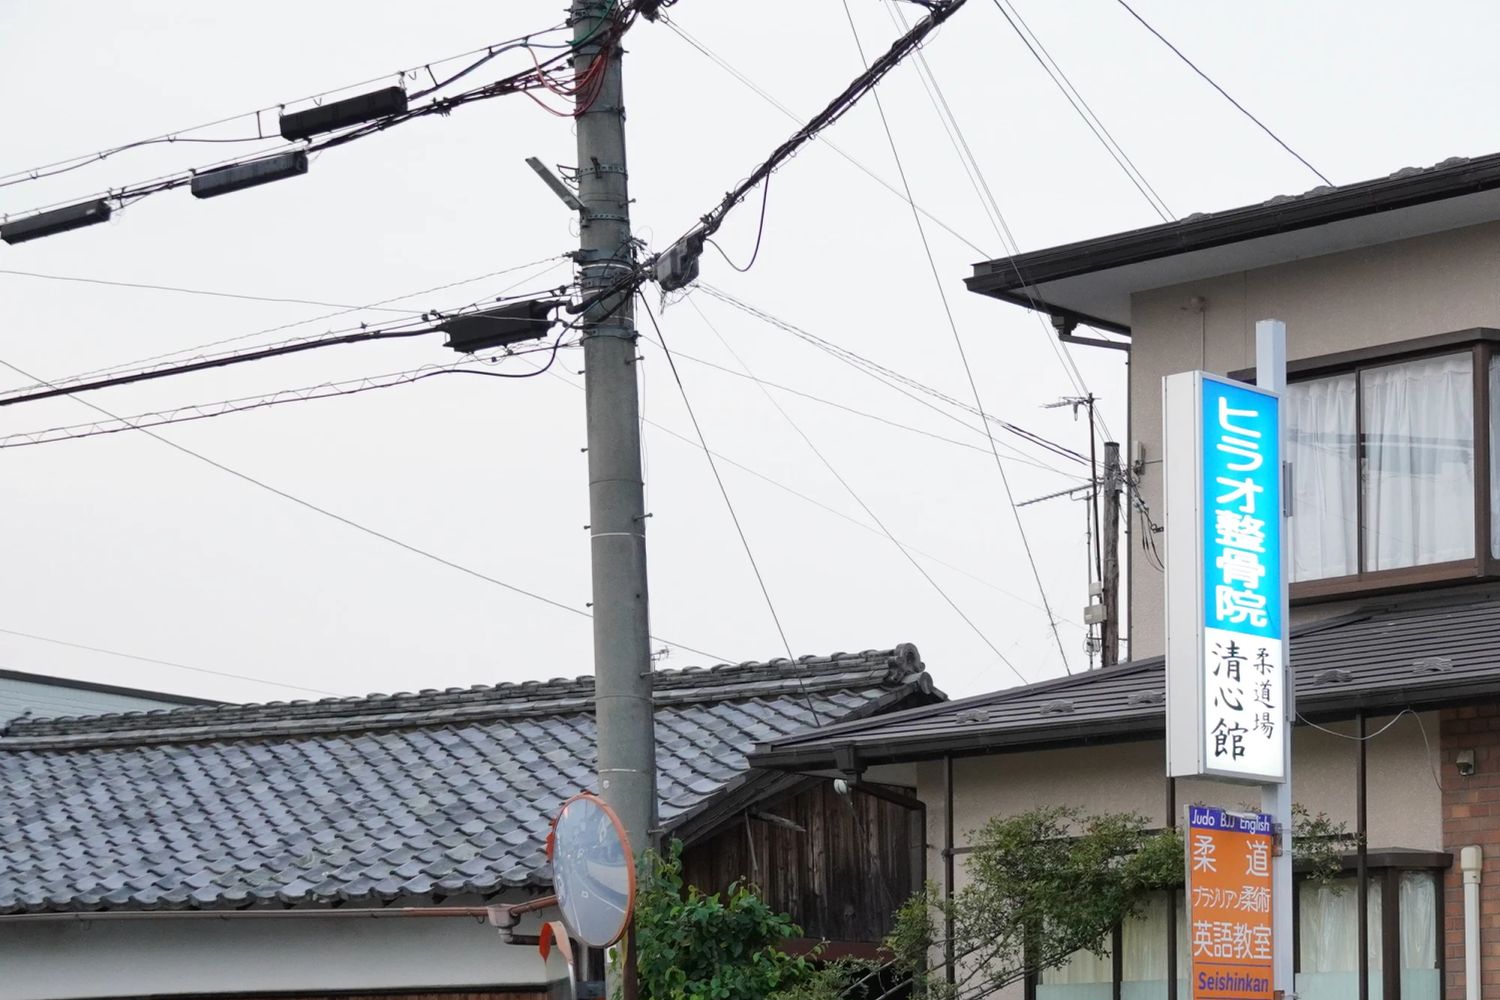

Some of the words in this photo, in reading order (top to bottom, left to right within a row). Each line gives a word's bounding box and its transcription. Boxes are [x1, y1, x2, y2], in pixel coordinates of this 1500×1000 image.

[1215, 396, 1268, 629] ヒラオ整骨院
[1210, 639, 1249, 763] 清心館
[1253, 647, 1275, 740] 柔道場
[1192, 808, 1216, 827] Judo
[1220, 811, 1235, 829] BJJ
[1240, 815, 1271, 836] English
[1193, 920, 1273, 961] 英語教室
[1198, 972, 1269, 994] Seishinkan
